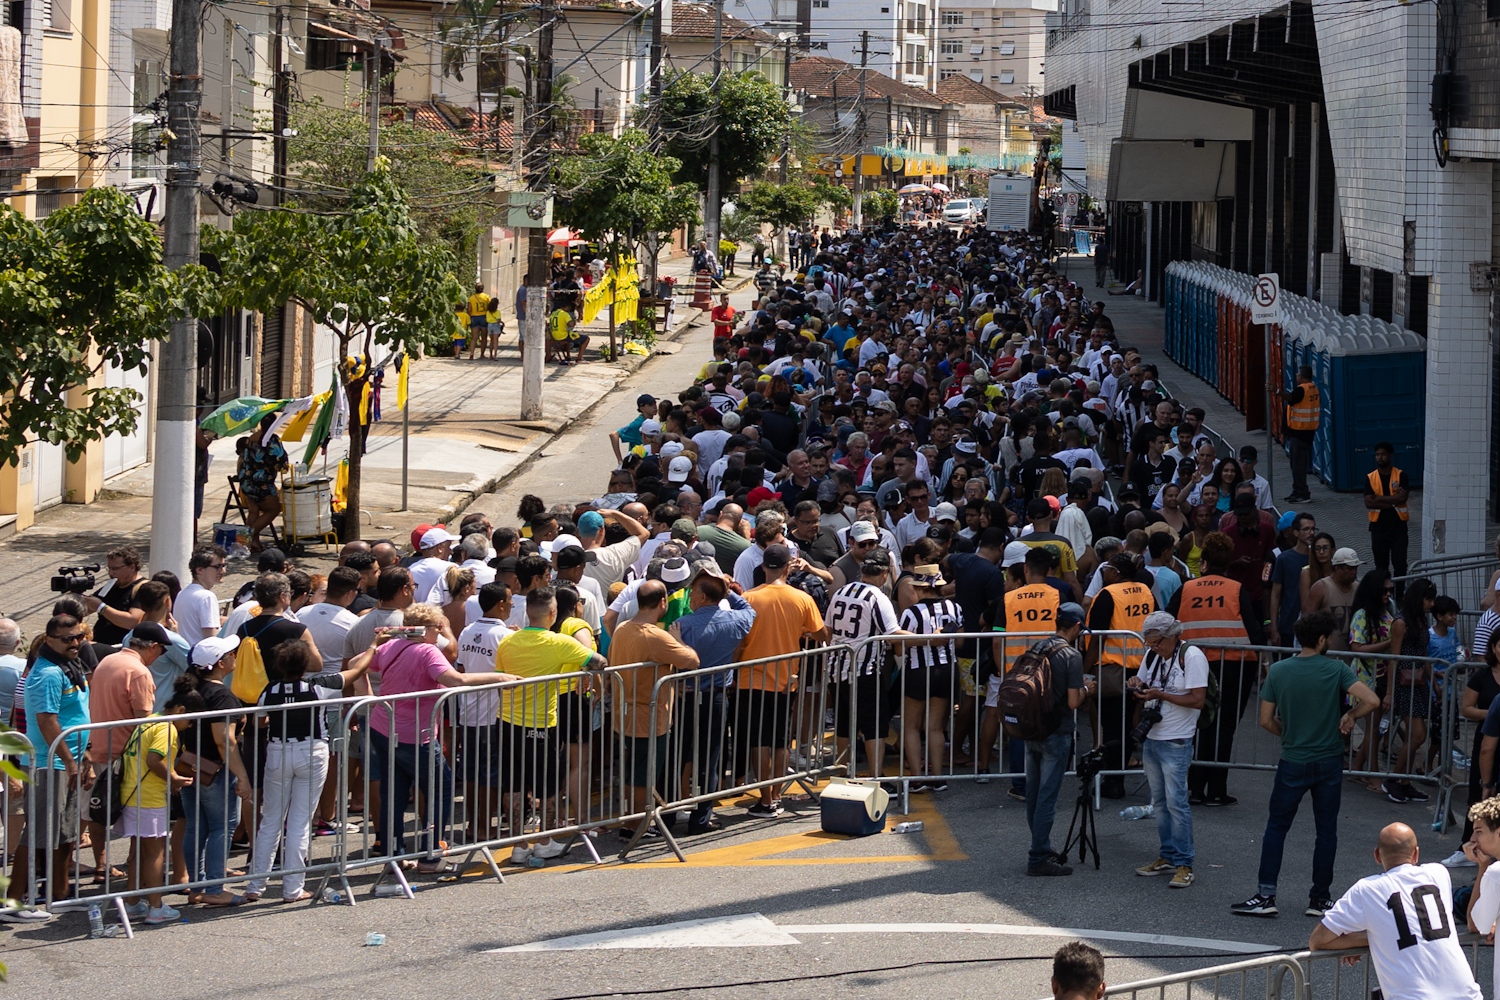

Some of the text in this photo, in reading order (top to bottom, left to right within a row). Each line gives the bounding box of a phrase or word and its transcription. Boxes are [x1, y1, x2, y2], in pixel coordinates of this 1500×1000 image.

[1127, 205, 1139, 213] 26
[1261, 283, 1270, 300] E
[475, 302, 486, 313] 13
[1017, 591, 1046, 599] STAFF
[1122, 586, 1143, 595] STAFF
[1191, 595, 1225, 609] 211
[1013, 608, 1053, 623] 102
[1124, 603, 1150, 617] 128
[832, 600, 863, 638] 23
[462, 644, 493, 657] SANTOS
[1386, 885, 1451, 951] 10
